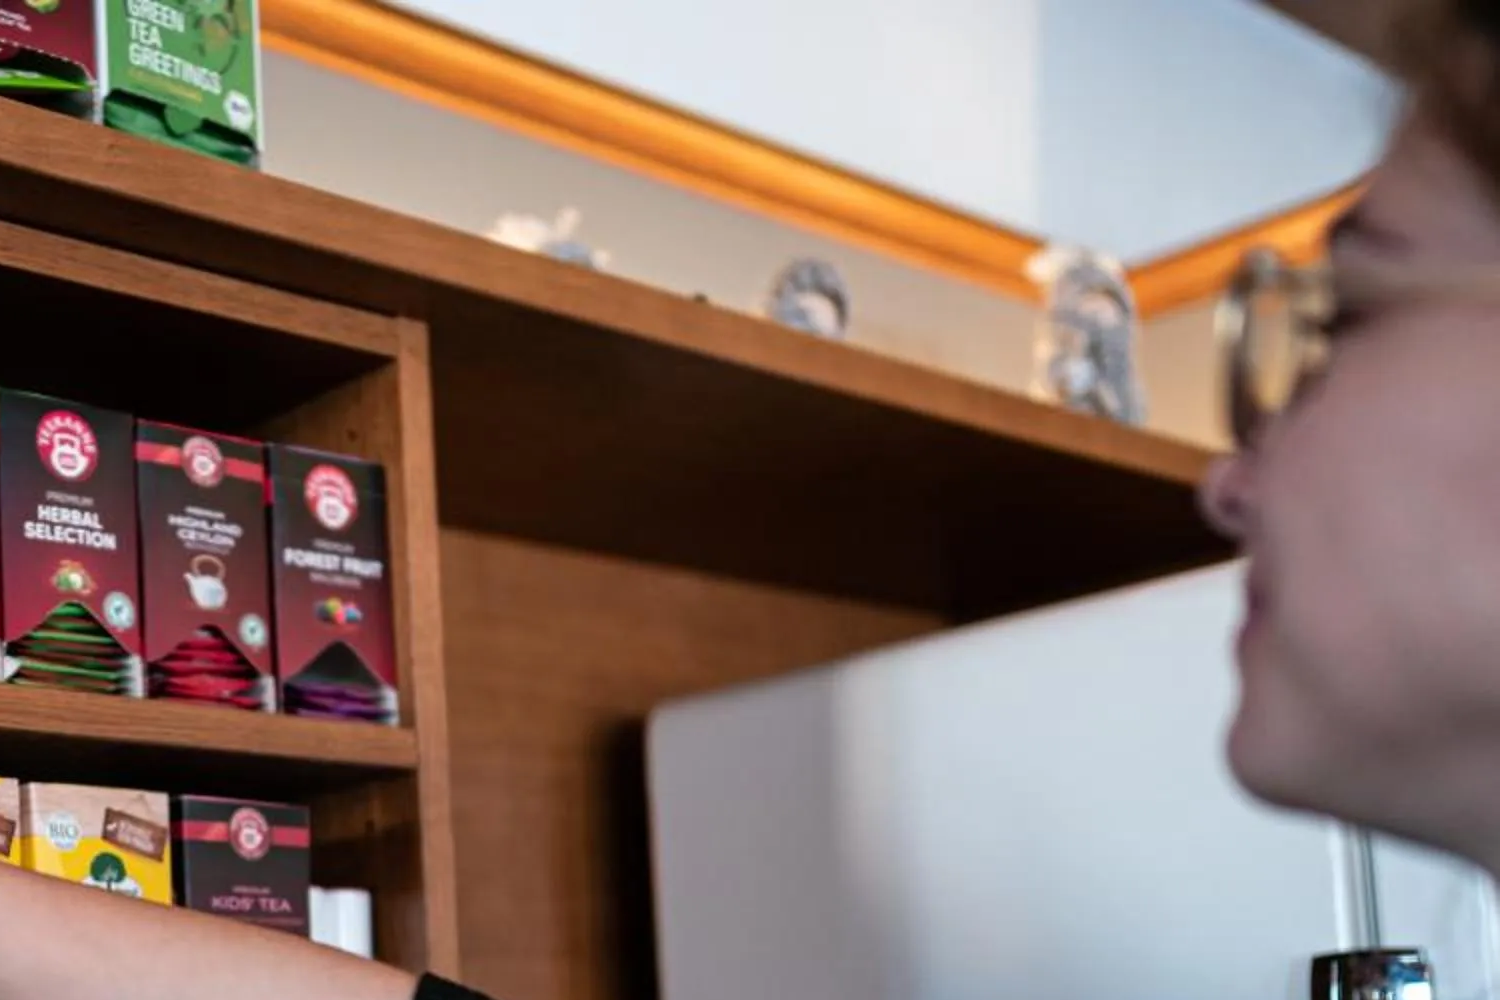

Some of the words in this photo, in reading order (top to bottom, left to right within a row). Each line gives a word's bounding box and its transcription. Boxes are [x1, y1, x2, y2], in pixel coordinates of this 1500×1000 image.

[126, 18, 162, 48] TEA
[129, 43, 222, 95] GREETINGS
[37, 504, 103, 529] HERBAL
[23, 521, 117, 550] SELECTION
[284, 547, 341, 571] FOREST
[259, 897, 292, 913] TEA
